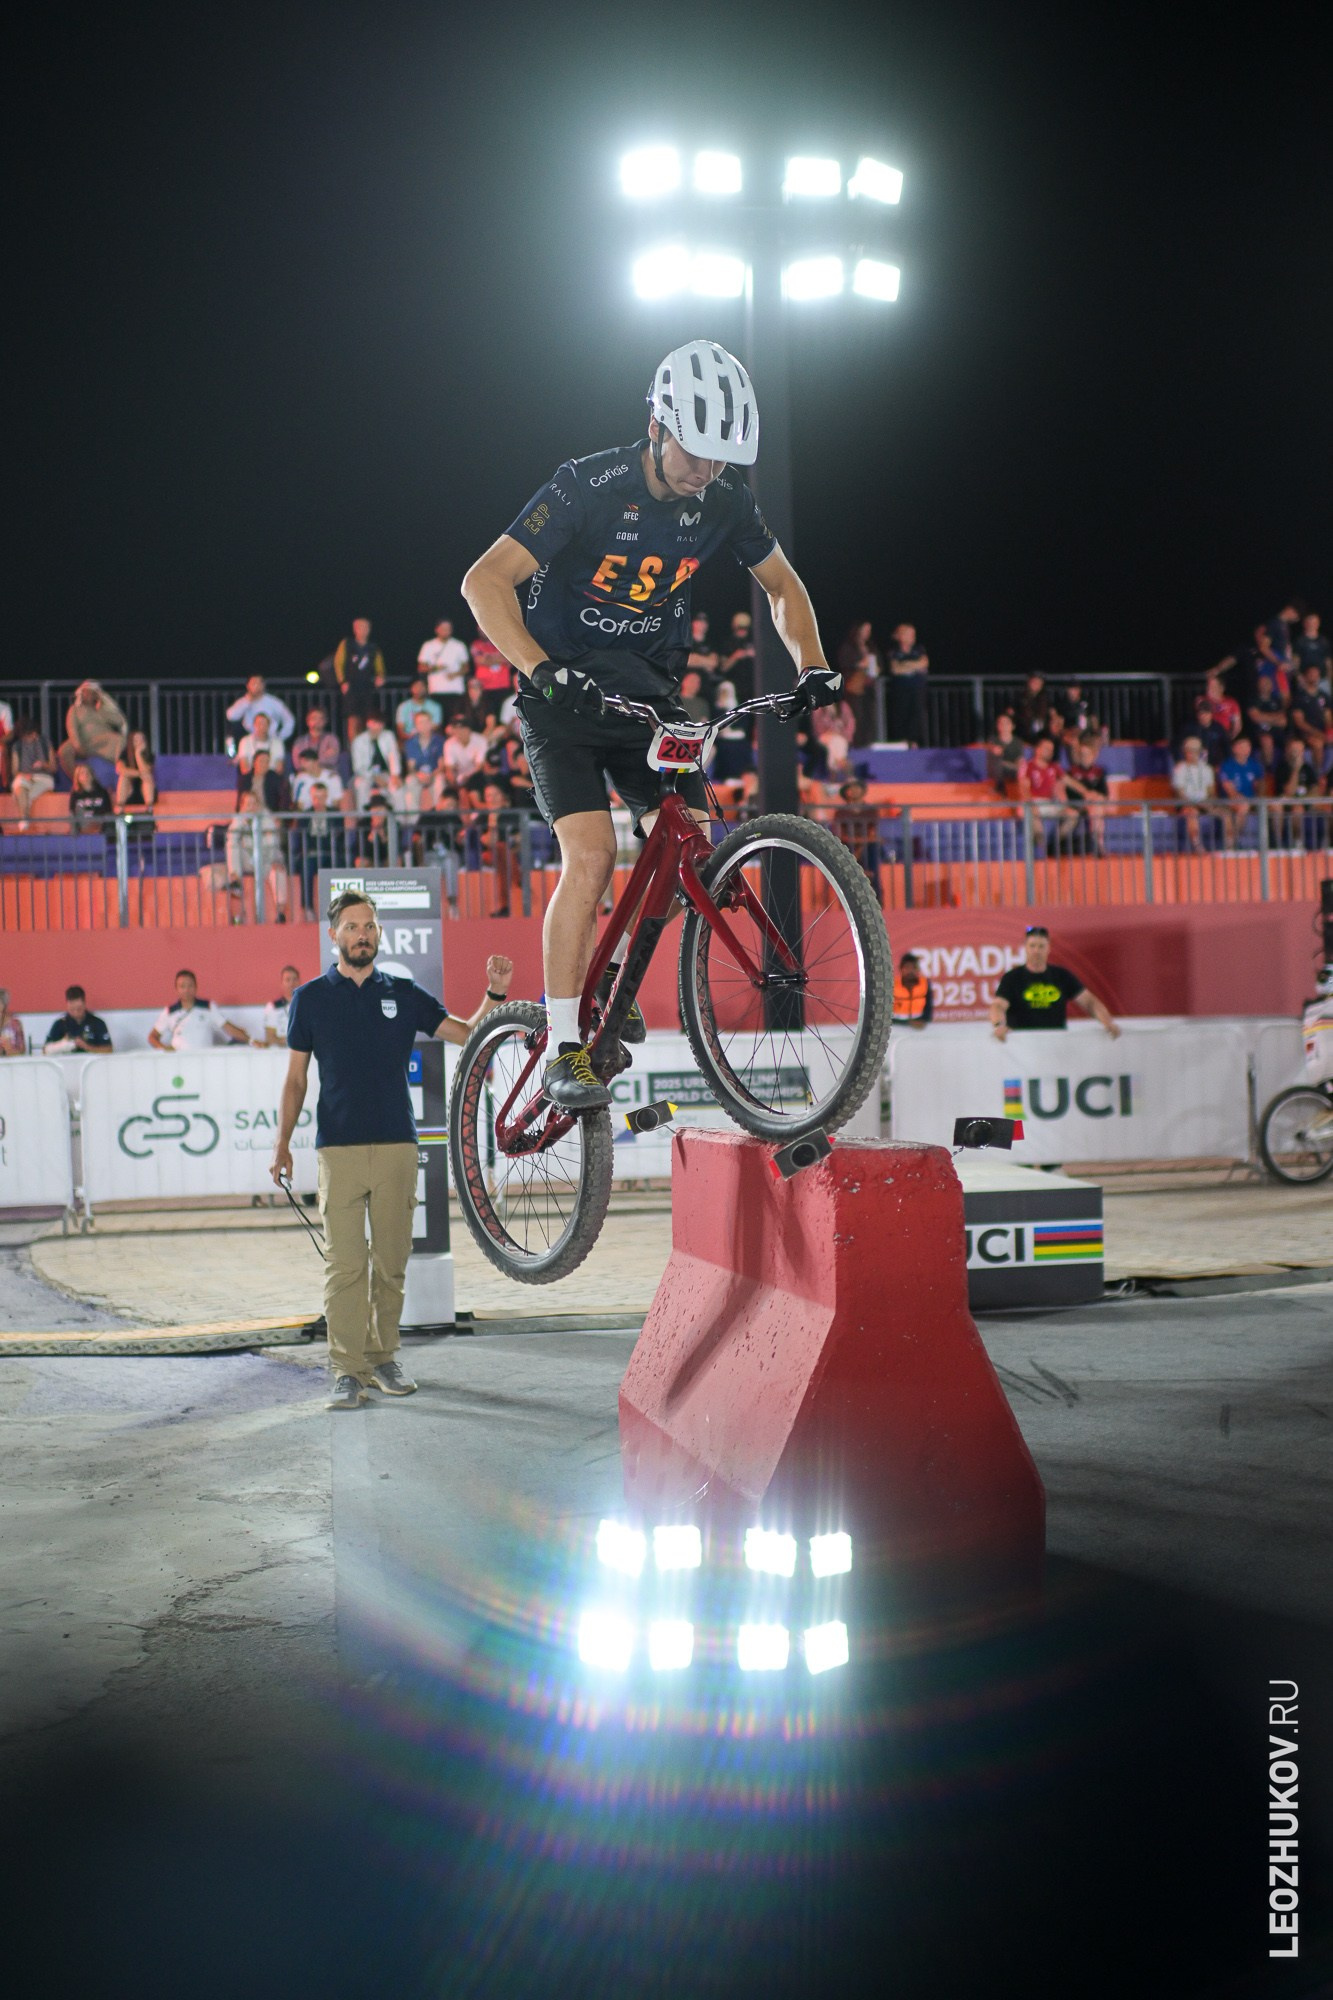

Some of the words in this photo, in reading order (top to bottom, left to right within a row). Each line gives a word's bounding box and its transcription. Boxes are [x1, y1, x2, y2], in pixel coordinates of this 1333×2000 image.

[589, 464, 629, 487] Cofidis
[524, 503, 550, 535] ESP
[616, 531, 639, 541] GOBIK
[579, 607, 662, 636] Cofidis
[661, 740, 700, 759] 203
[932, 981, 977, 1006] 025
[610, 1079, 641, 1103] CI
[653, 1078, 681, 1089] 2025
[1028, 1074, 1133, 1119] UCI
